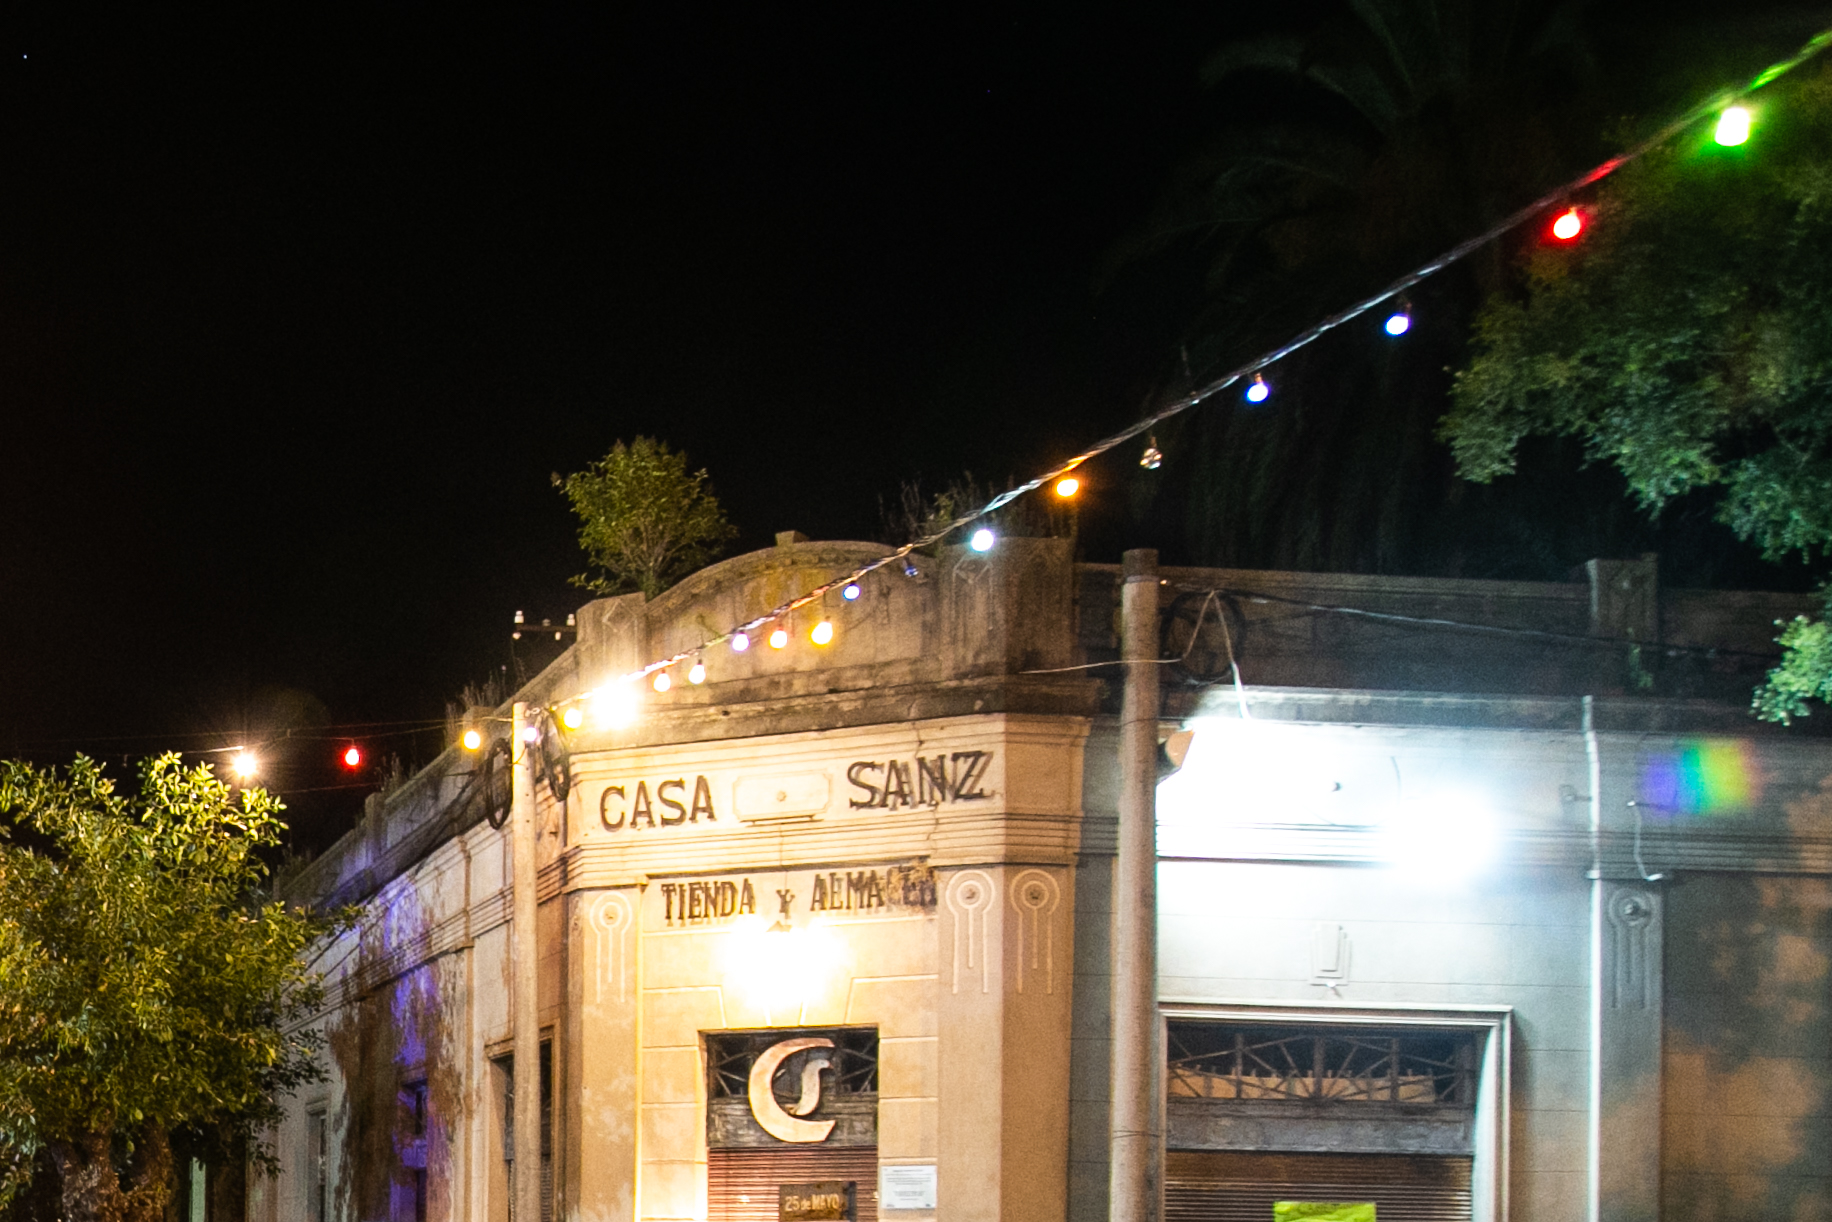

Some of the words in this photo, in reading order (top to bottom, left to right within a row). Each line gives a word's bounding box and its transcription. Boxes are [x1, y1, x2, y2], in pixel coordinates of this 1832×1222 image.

[599, 775, 717, 833] CASA
[847, 750, 993, 811] SANZ
[660, 877, 757, 921] TIENDA
[784, 1194, 801, 1212] 25
[800, 1198, 812, 1211] de
[811, 1193, 840, 1211] MAYO
